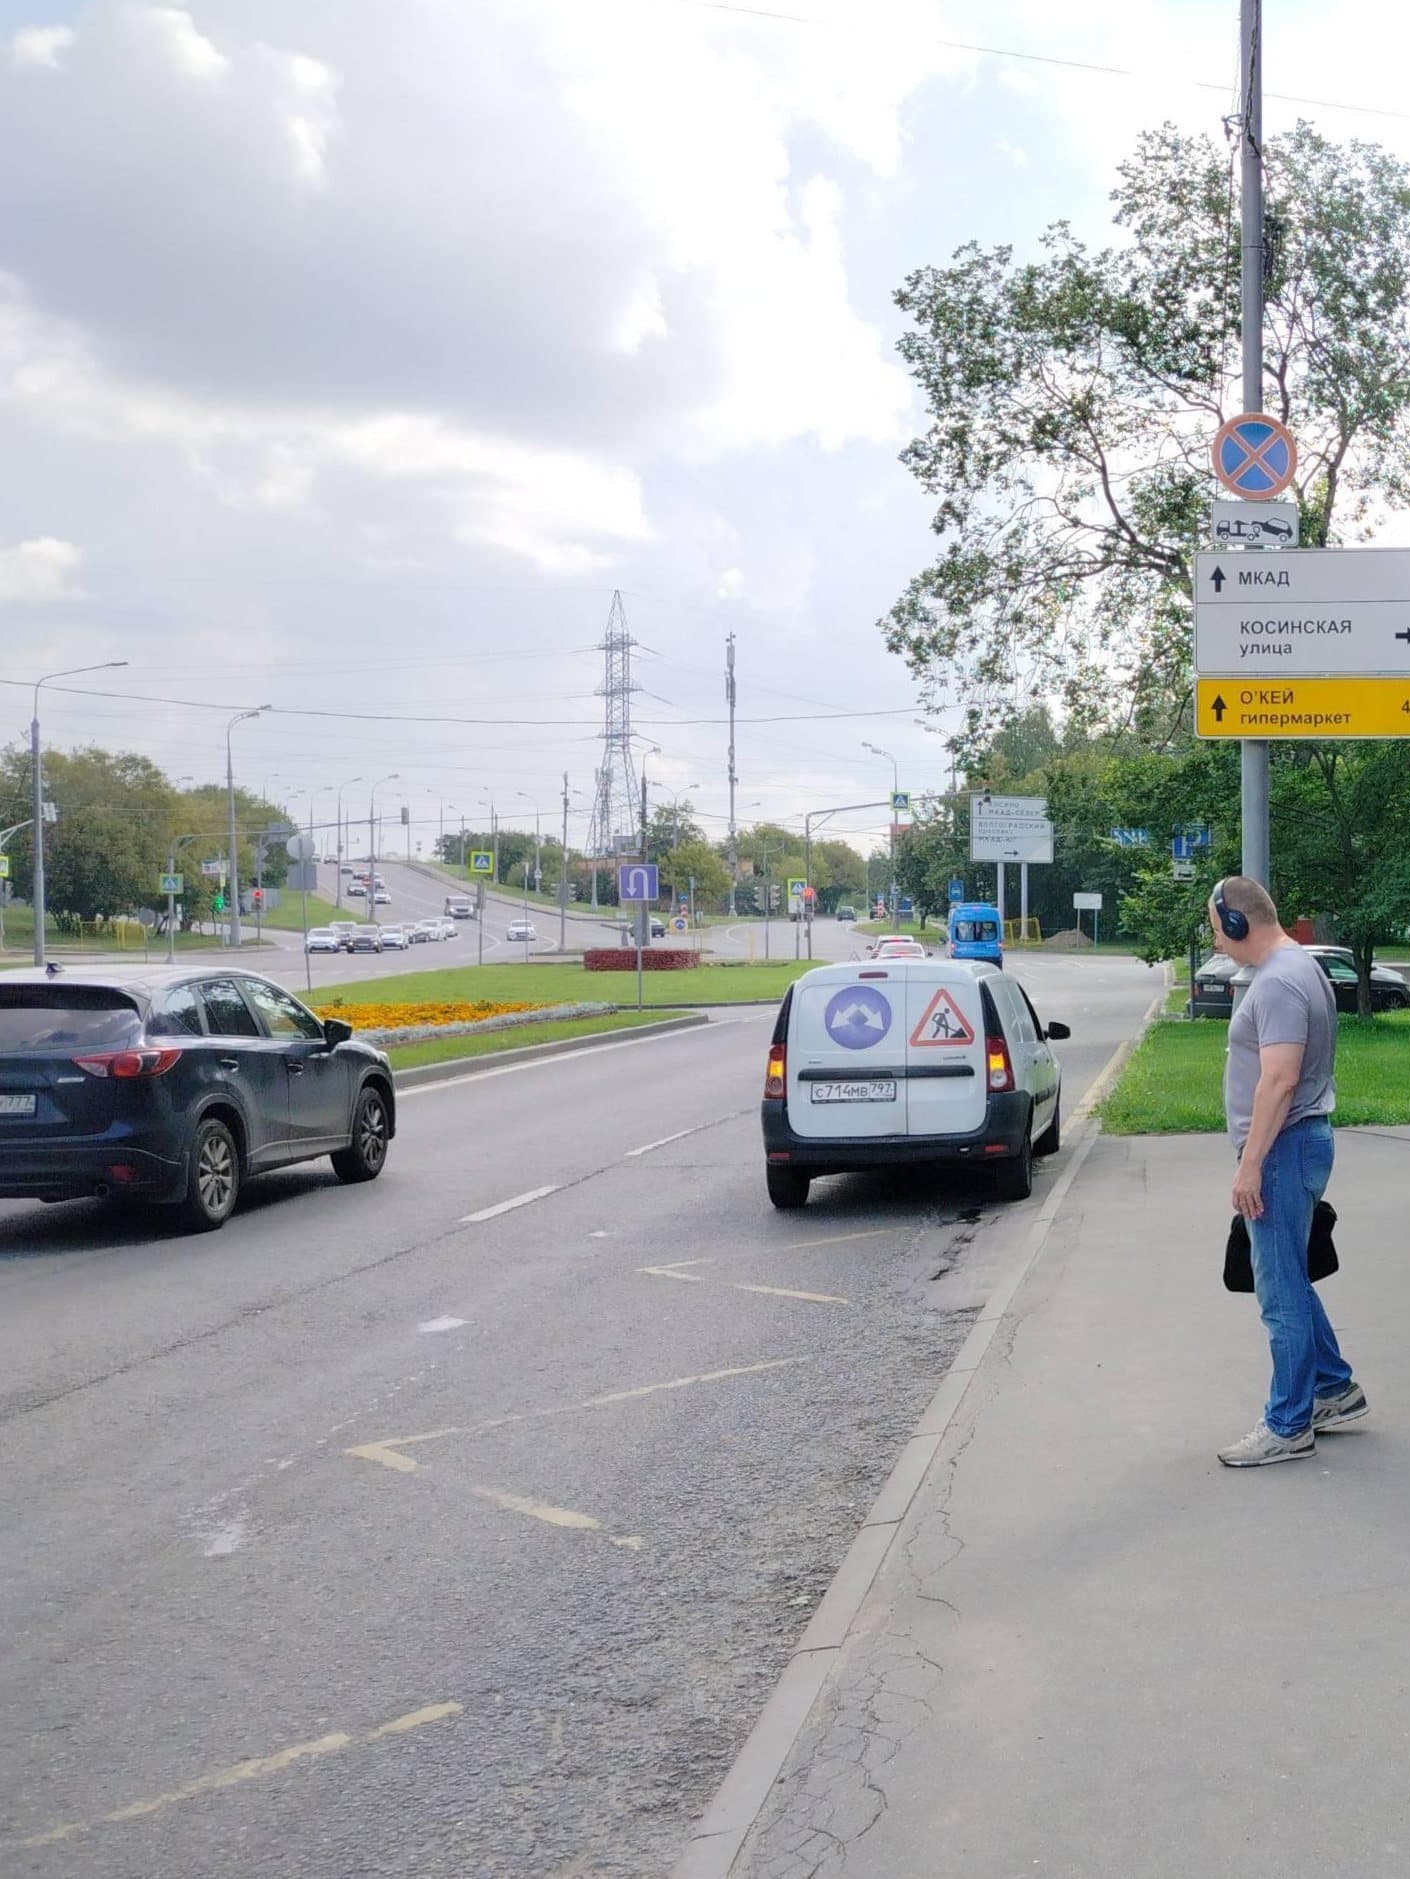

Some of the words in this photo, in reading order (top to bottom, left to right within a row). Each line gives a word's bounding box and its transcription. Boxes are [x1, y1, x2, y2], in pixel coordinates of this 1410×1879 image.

[1238, 571, 1290, 587] МКАД
[1240, 620, 1352, 635] КОСИНСКАЯ
[1240, 643, 1293, 656] улица
[1240, 713, 1352, 728] гипермаркет
[815, 1084, 868, 1098] С714МВ
[871, 1083, 891, 1094] 797
[8, 1096, 31, 1107] 777
